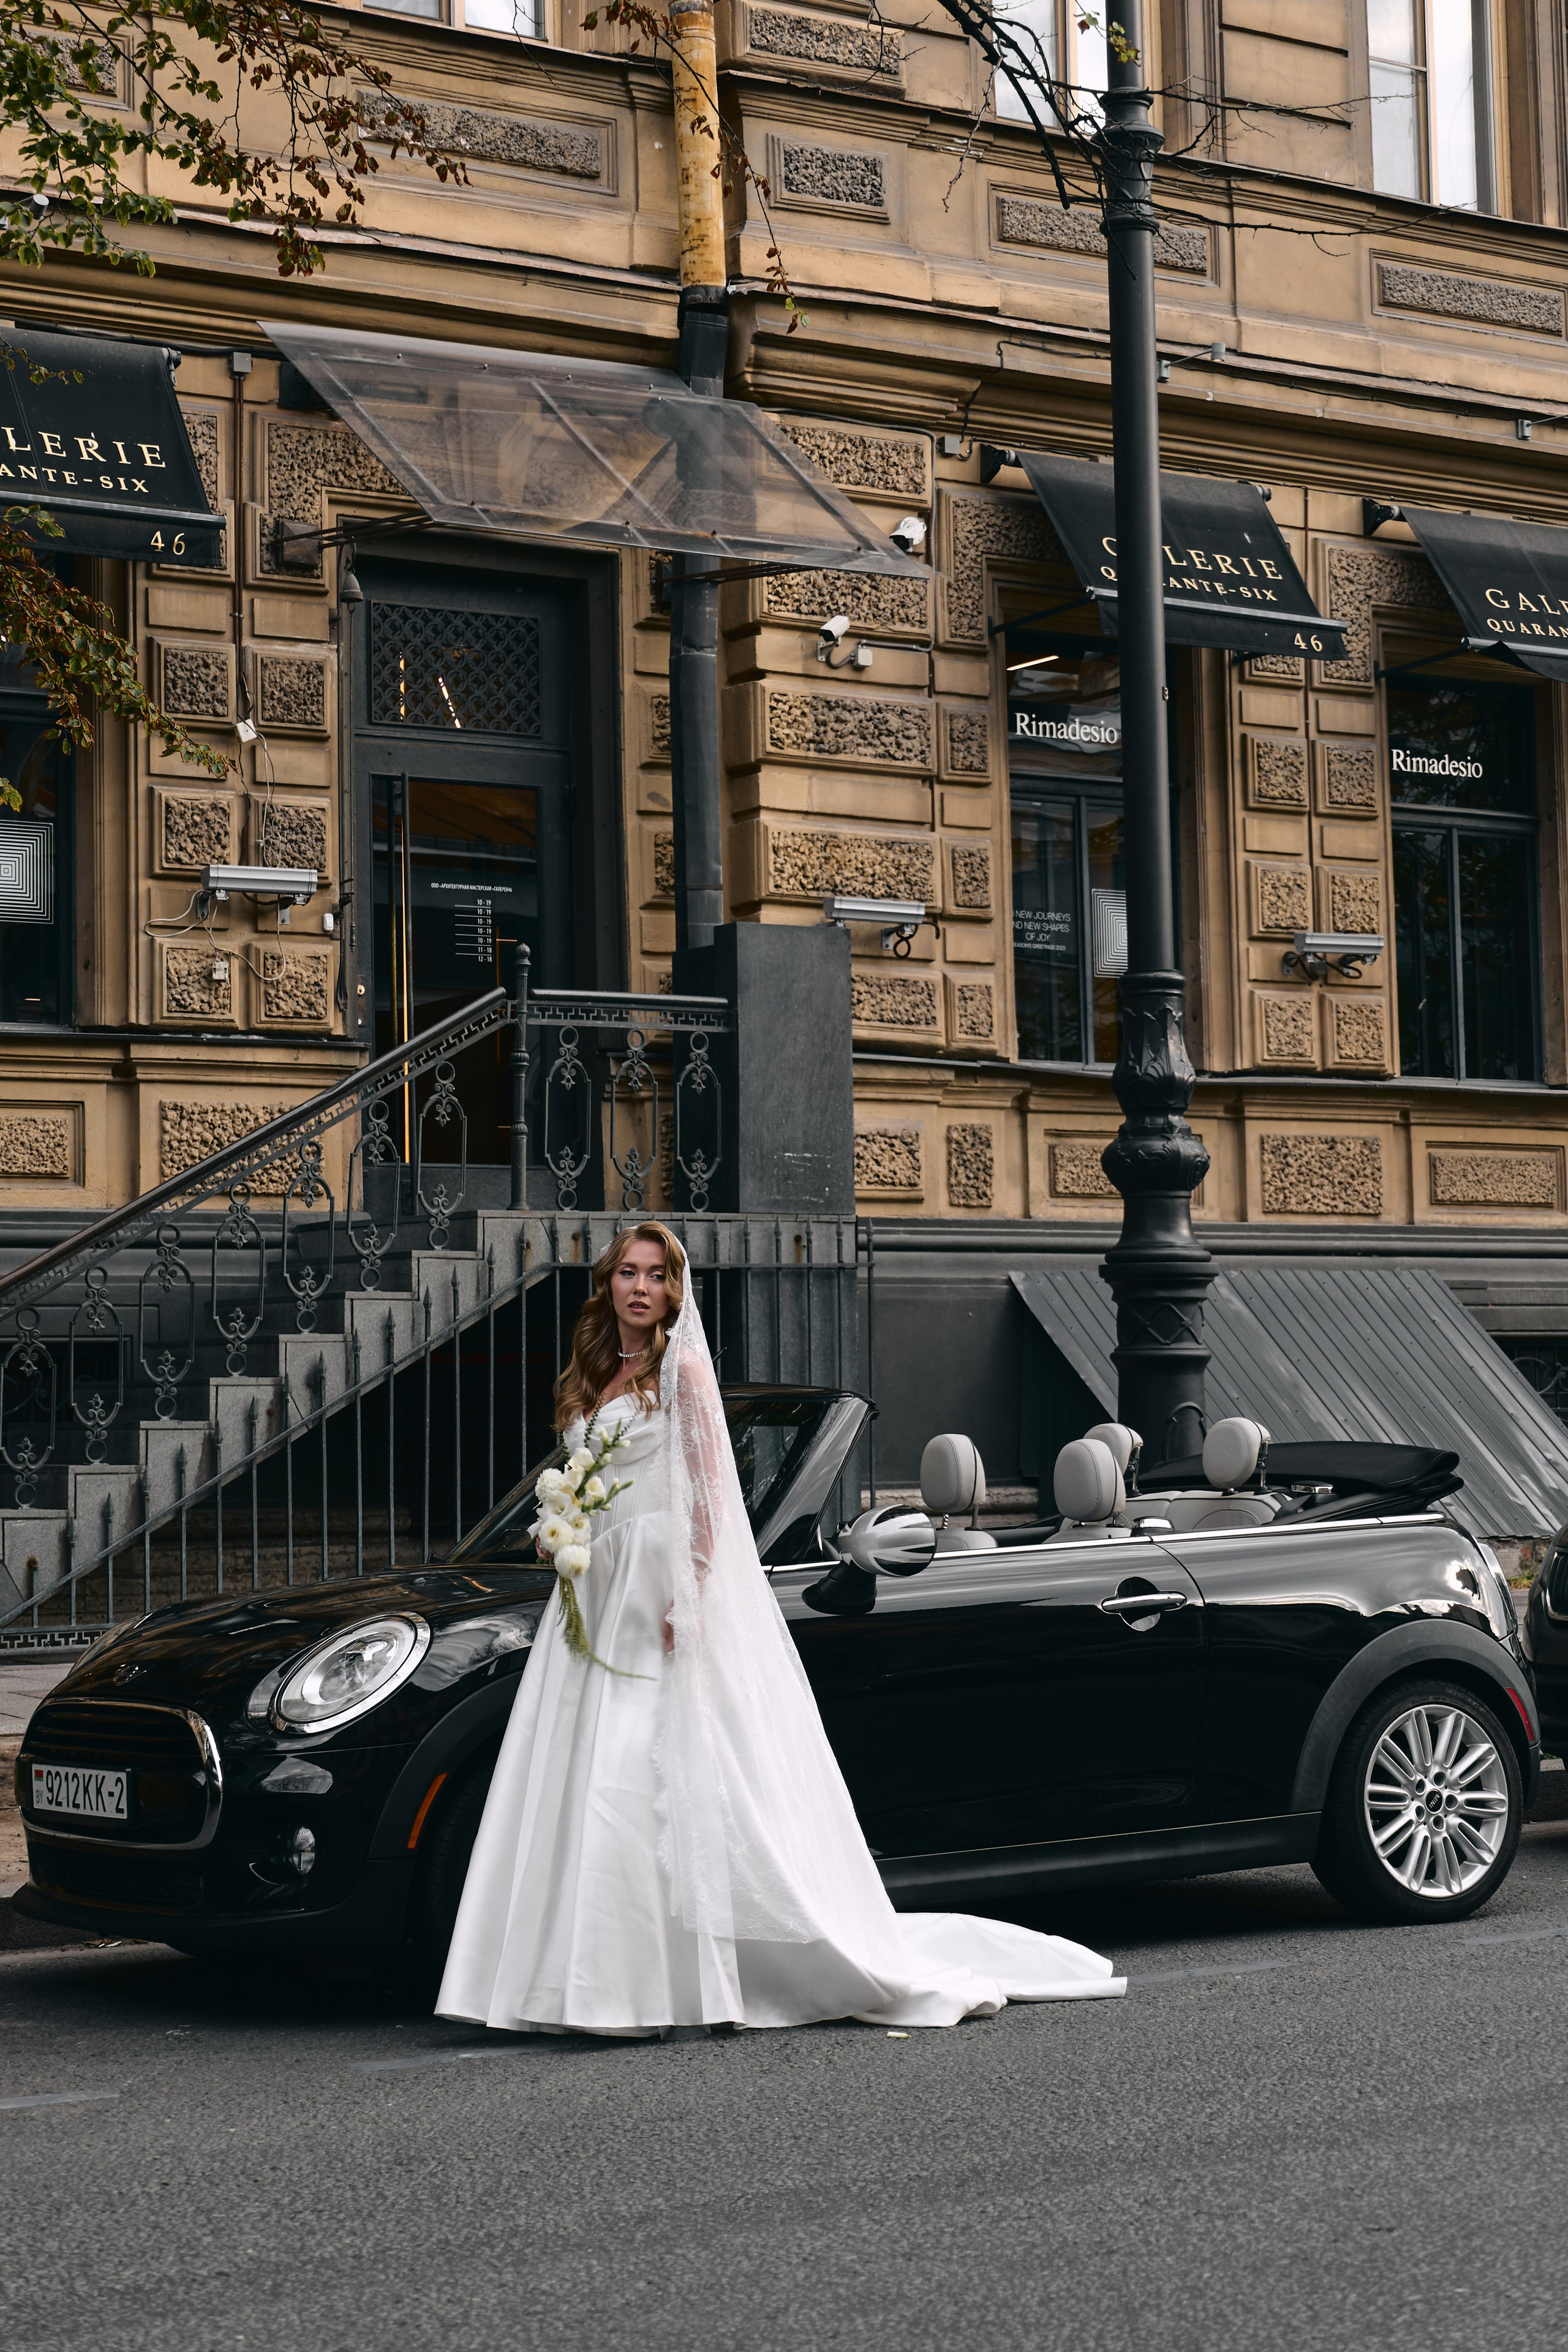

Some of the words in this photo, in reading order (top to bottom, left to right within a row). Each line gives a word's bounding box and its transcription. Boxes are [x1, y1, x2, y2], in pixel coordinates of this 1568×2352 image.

[1, 426, 166, 468] LERIE
[150, 530, 186, 555] 46
[1102, 537, 1283, 580] GLERIE
[1100, 566, 1278, 601] QANTE-SIX
[1294, 632, 1324, 652] 46
[1014, 712, 1118, 744] Rimadesio
[1391, 748, 1483, 778] Rimadesio
[1016, 910, 1031, 919] NEW
[1033, 911, 1071, 921] JOURNEYS
[1024, 922, 1041, 930] NEW
[1042, 922, 1069, 932] SHAPES
[36, 1790, 43, 1804] BY
[46, 1770, 125, 1814] 9212KK-2
